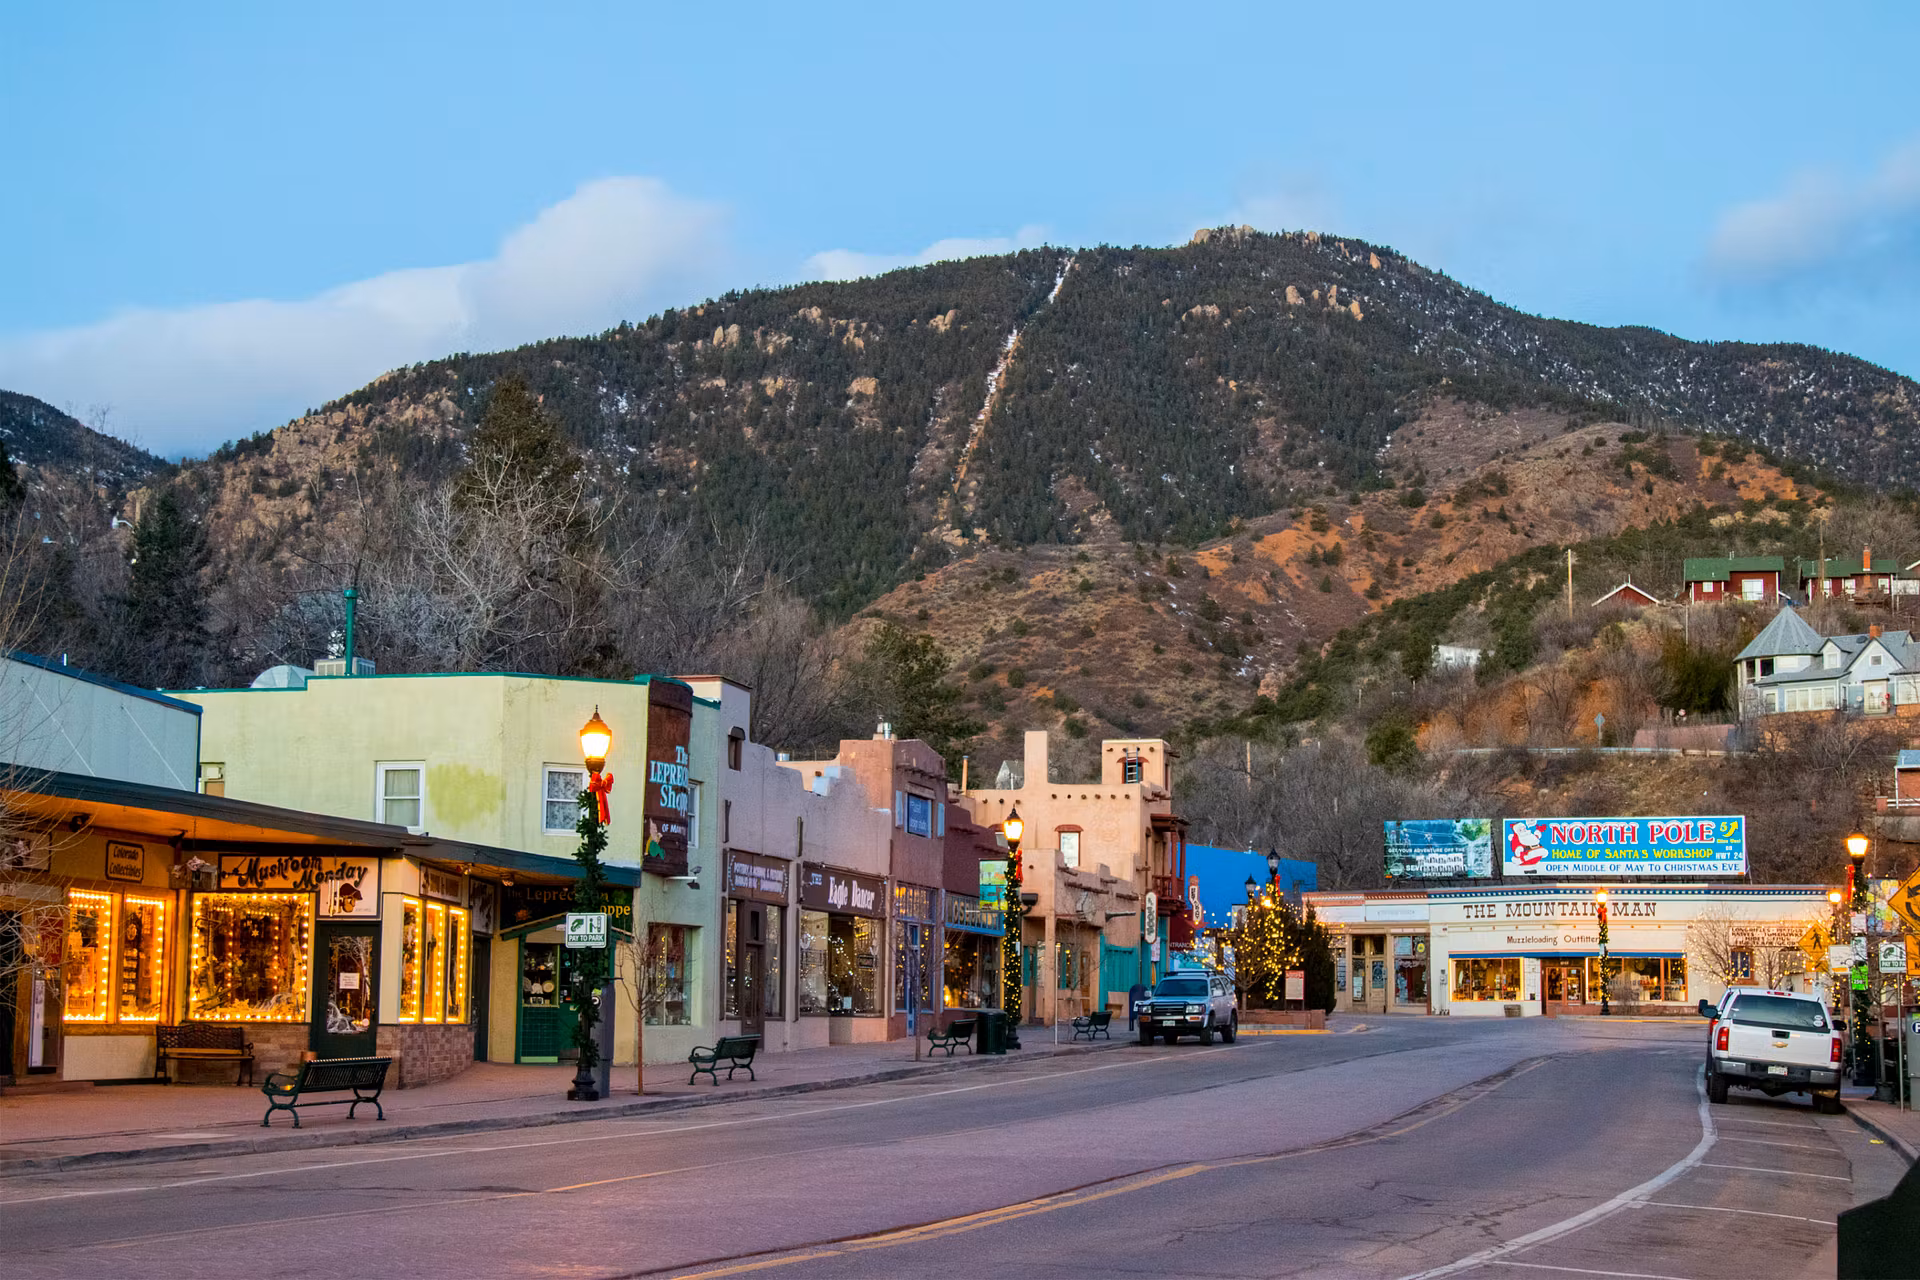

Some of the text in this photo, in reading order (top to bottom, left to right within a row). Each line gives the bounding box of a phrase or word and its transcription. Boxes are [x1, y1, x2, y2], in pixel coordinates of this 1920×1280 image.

[1549, 820, 1716, 844] NORTH POLE
[1719, 821, 1728, 832] 5
[113, 846, 139, 860] Colorado
[1551, 849, 1582, 859] HOME
[1604, 848, 1648, 859] SANTA'S
[1652, 848, 1714, 859] WORKSHOP
[109, 862, 142, 878] Collectibles
[238, 856, 323, 887] Mushroom
[292, 861, 369, 889] Monday
[1545, 864, 1569, 872] OPEN
[1572, 863, 1605, 872] MIDDLE
[1609, 863, 1621, 872] OF
[1624, 863, 1645, 872] MAY
[1664, 863, 1719, 872] CHRISTMAS
[1721, 863, 1740, 871] EVE
[827, 876, 849, 909] Eagle
[851, 880, 876, 910] Dancer
[1463, 902, 1657, 918] THE MOUNTAIN MAN
[1506, 935, 1558, 946] Muzzleloading
